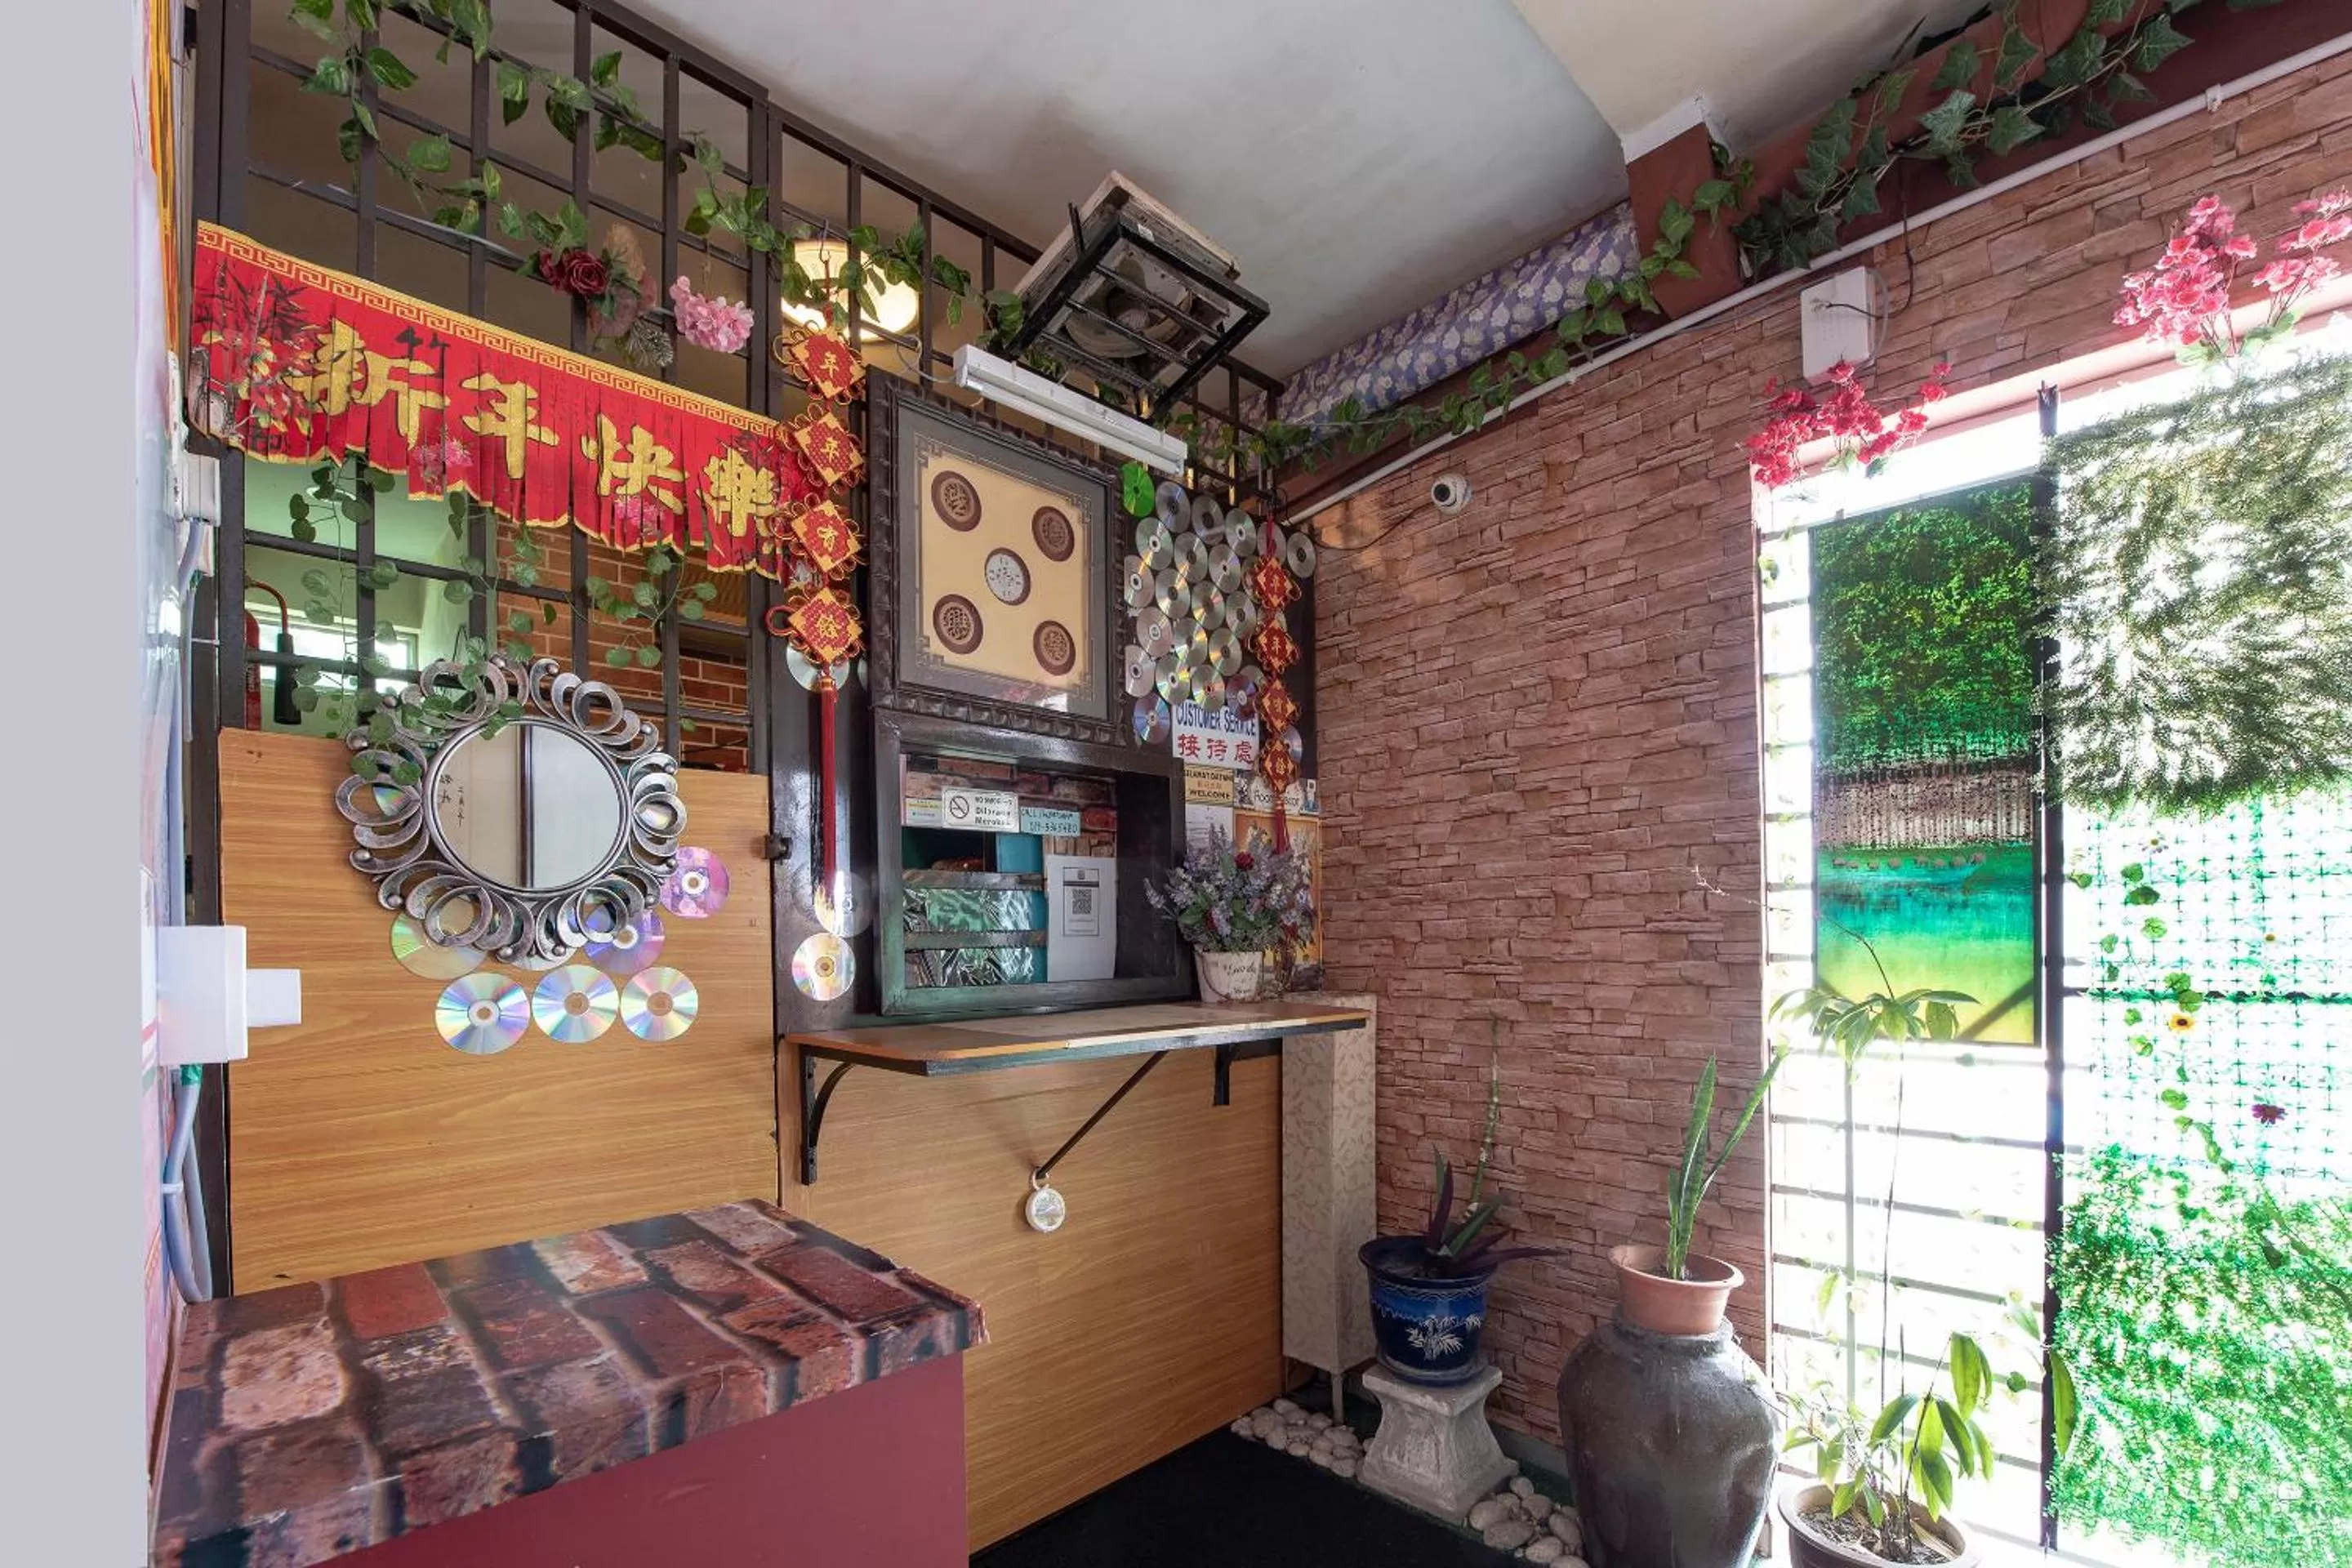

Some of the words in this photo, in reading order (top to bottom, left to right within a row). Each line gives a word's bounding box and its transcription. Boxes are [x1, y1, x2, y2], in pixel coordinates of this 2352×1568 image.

[1178, 733, 1254, 764] 接待處
[1189, 790, 1230, 800] WELCOME
